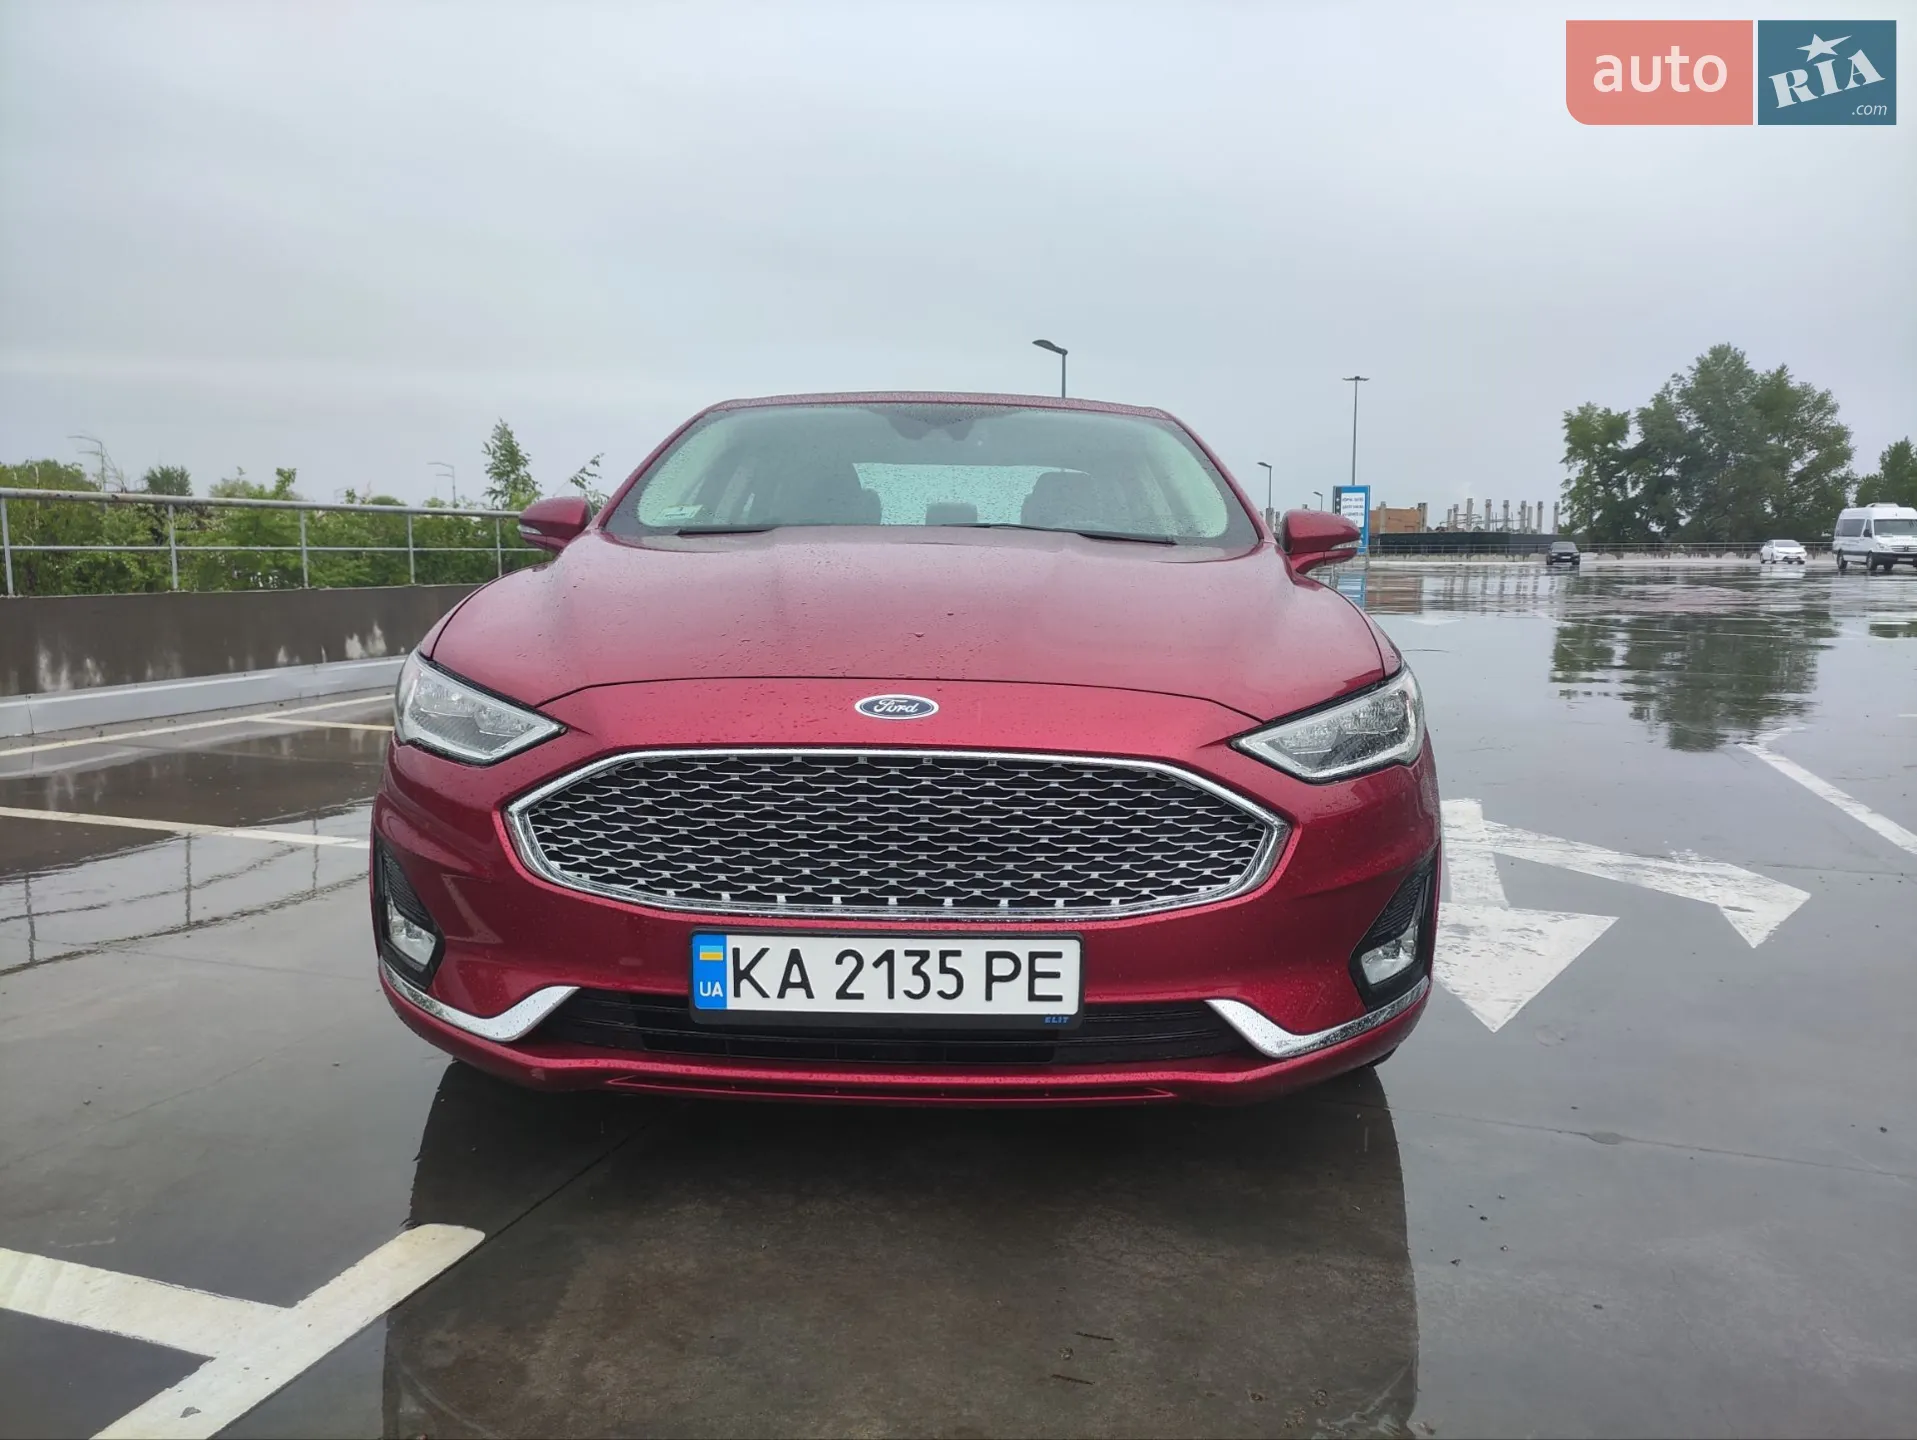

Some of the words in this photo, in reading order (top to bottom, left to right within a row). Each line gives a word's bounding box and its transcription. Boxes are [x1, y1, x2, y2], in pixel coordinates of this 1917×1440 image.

[873, 699, 920, 713] Ford
[731, 946, 815, 1000] KA
[835, 948, 964, 1001] 2135
[985, 950, 1063, 1002] PE
[699, 981, 724, 997] UA
